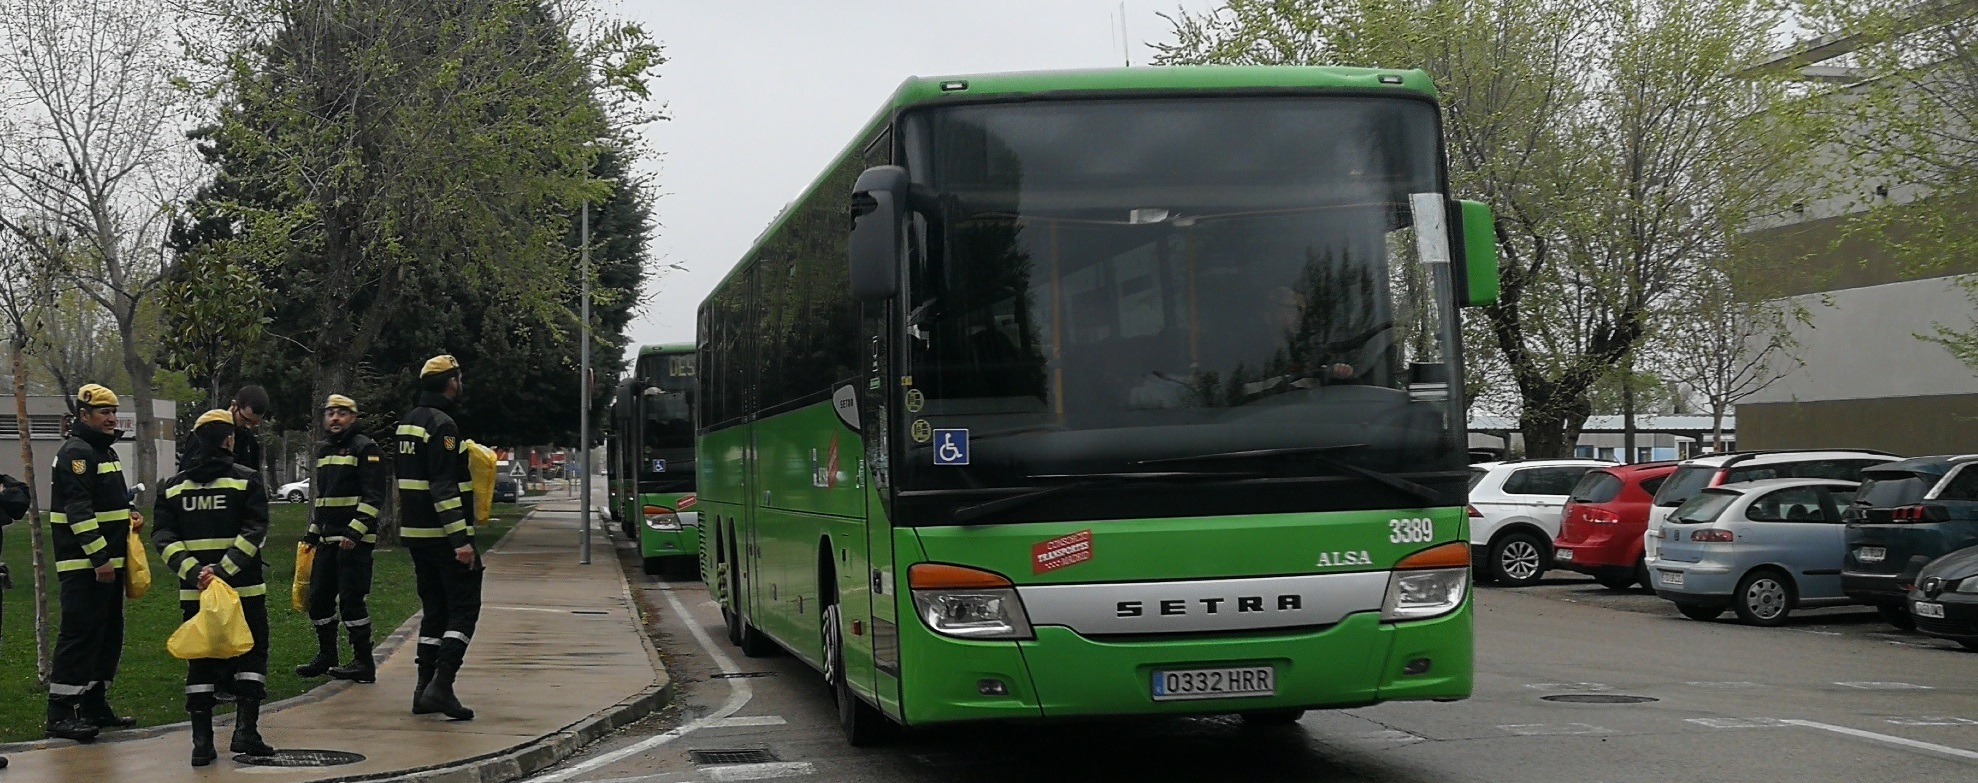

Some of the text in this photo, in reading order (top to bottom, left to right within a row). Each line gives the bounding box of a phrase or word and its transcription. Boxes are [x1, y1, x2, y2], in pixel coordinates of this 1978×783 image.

[182, 494, 228, 511] UME
[1389, 517, 1434, 544] 3389
[1037, 541, 1090, 563] TRANSPORTES
[1060, 551, 1090, 566] MADRID
[1316, 550, 1373, 567] ALSA
[1116, 594, 1302, 618] SETRA
[1166, 669, 1269, 692] 0332 HRR
